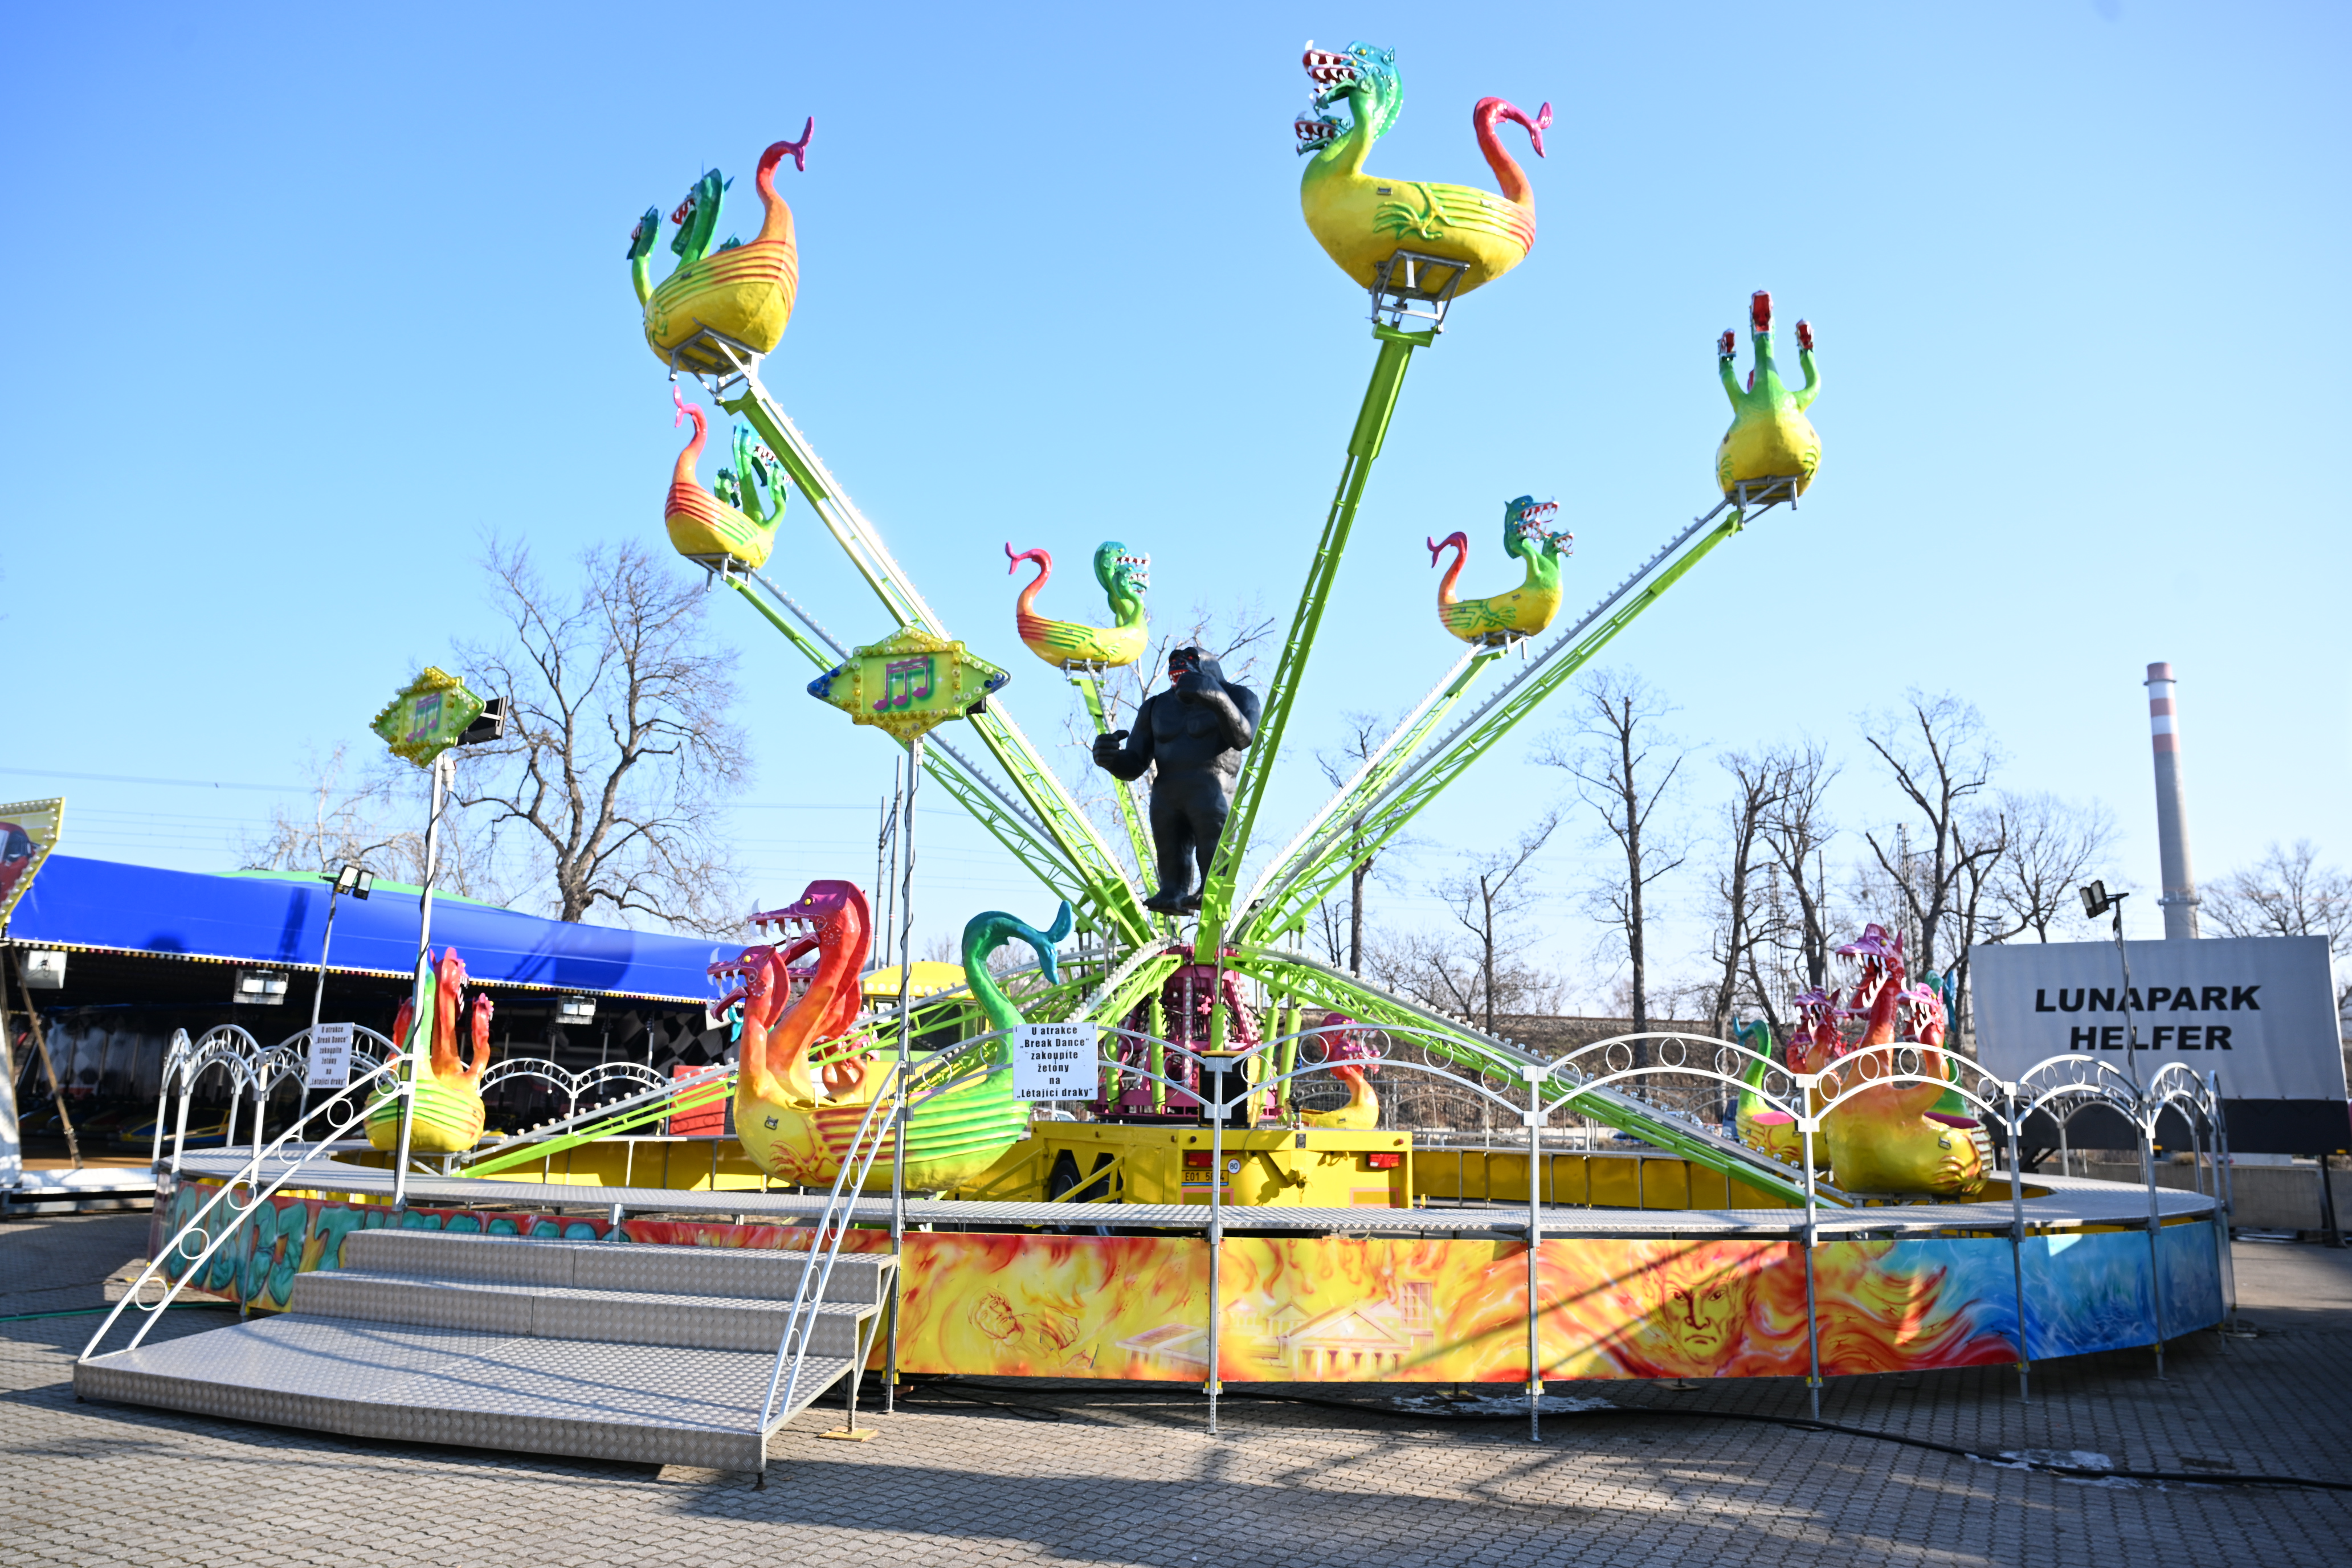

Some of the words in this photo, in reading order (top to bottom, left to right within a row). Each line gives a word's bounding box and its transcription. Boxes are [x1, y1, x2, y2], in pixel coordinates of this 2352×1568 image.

[2035, 986, 2261, 1012] LUNAPARK
[1031, 1027, 1037, 1035] U
[1040, 1026, 1077, 1035] atrakce
[2070, 1026, 2233, 1051] HELFER
[1031, 1051, 1079, 1060] zakoupíte
[1038, 1063, 1069, 1072] žetony
[1185, 1172, 1200, 1181] E01
